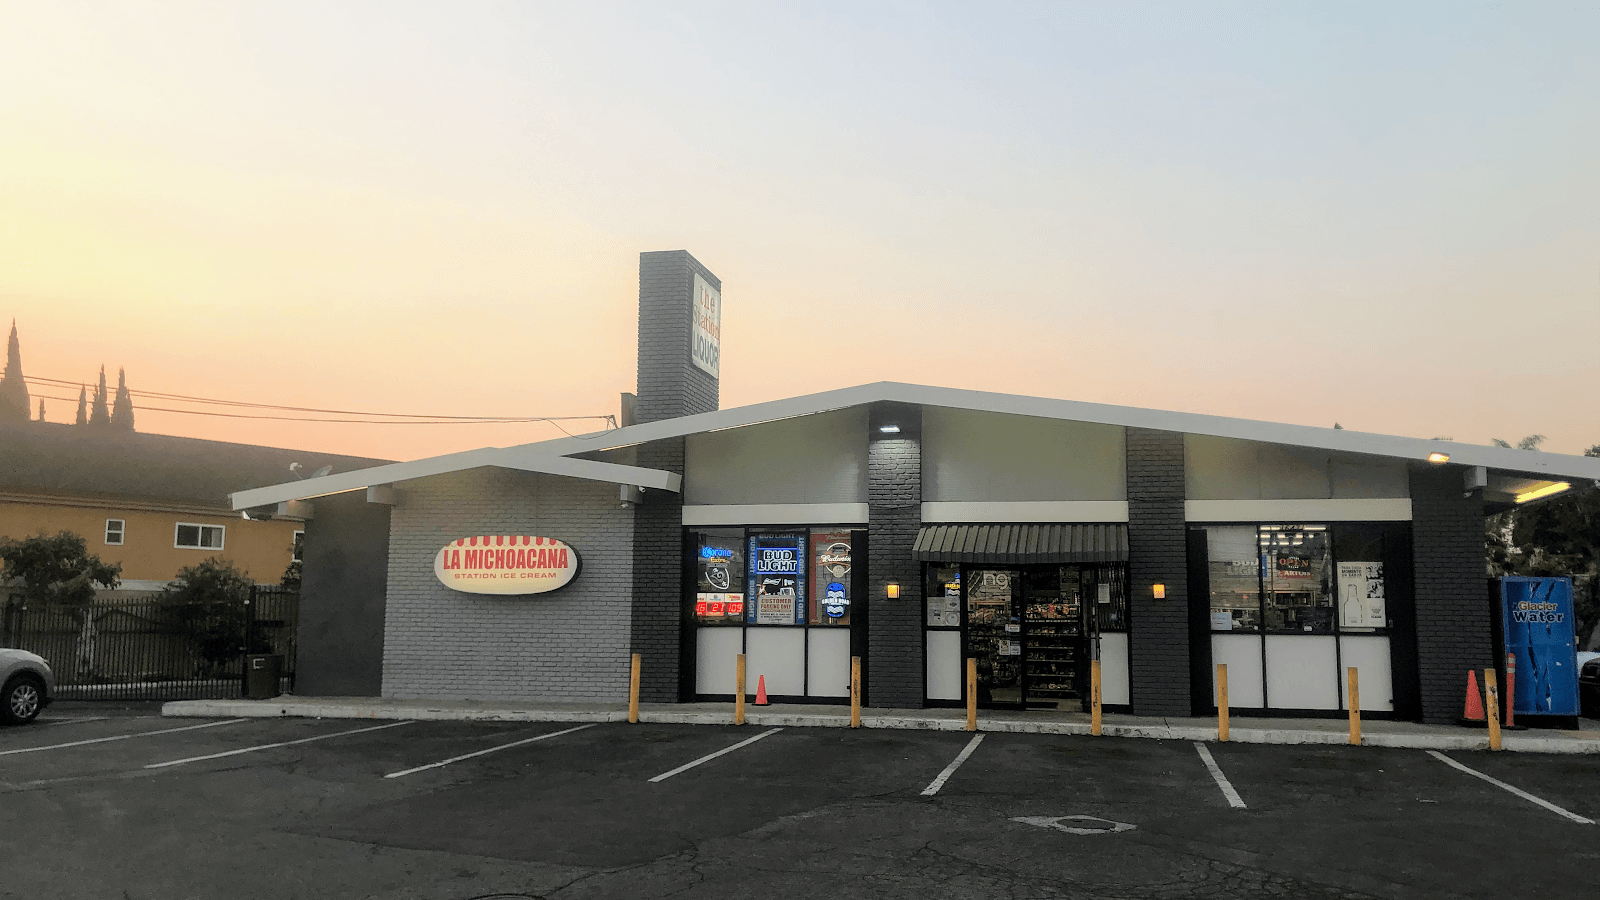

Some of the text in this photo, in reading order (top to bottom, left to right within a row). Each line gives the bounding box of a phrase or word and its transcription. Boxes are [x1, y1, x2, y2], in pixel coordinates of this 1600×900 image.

[700, 285, 715, 313] the
[692, 304, 720, 341] Station
[693, 330, 719, 370] LIQUOR
[443, 548, 568, 570] LA MICHOACANA
[763, 550, 793, 560] BUD
[758, 560, 797, 572] LIGHT
[1279, 558, 1309, 568] OPEN
[1518, 601, 1558, 611] Glacier
[1513, 610, 1565, 623] Water
